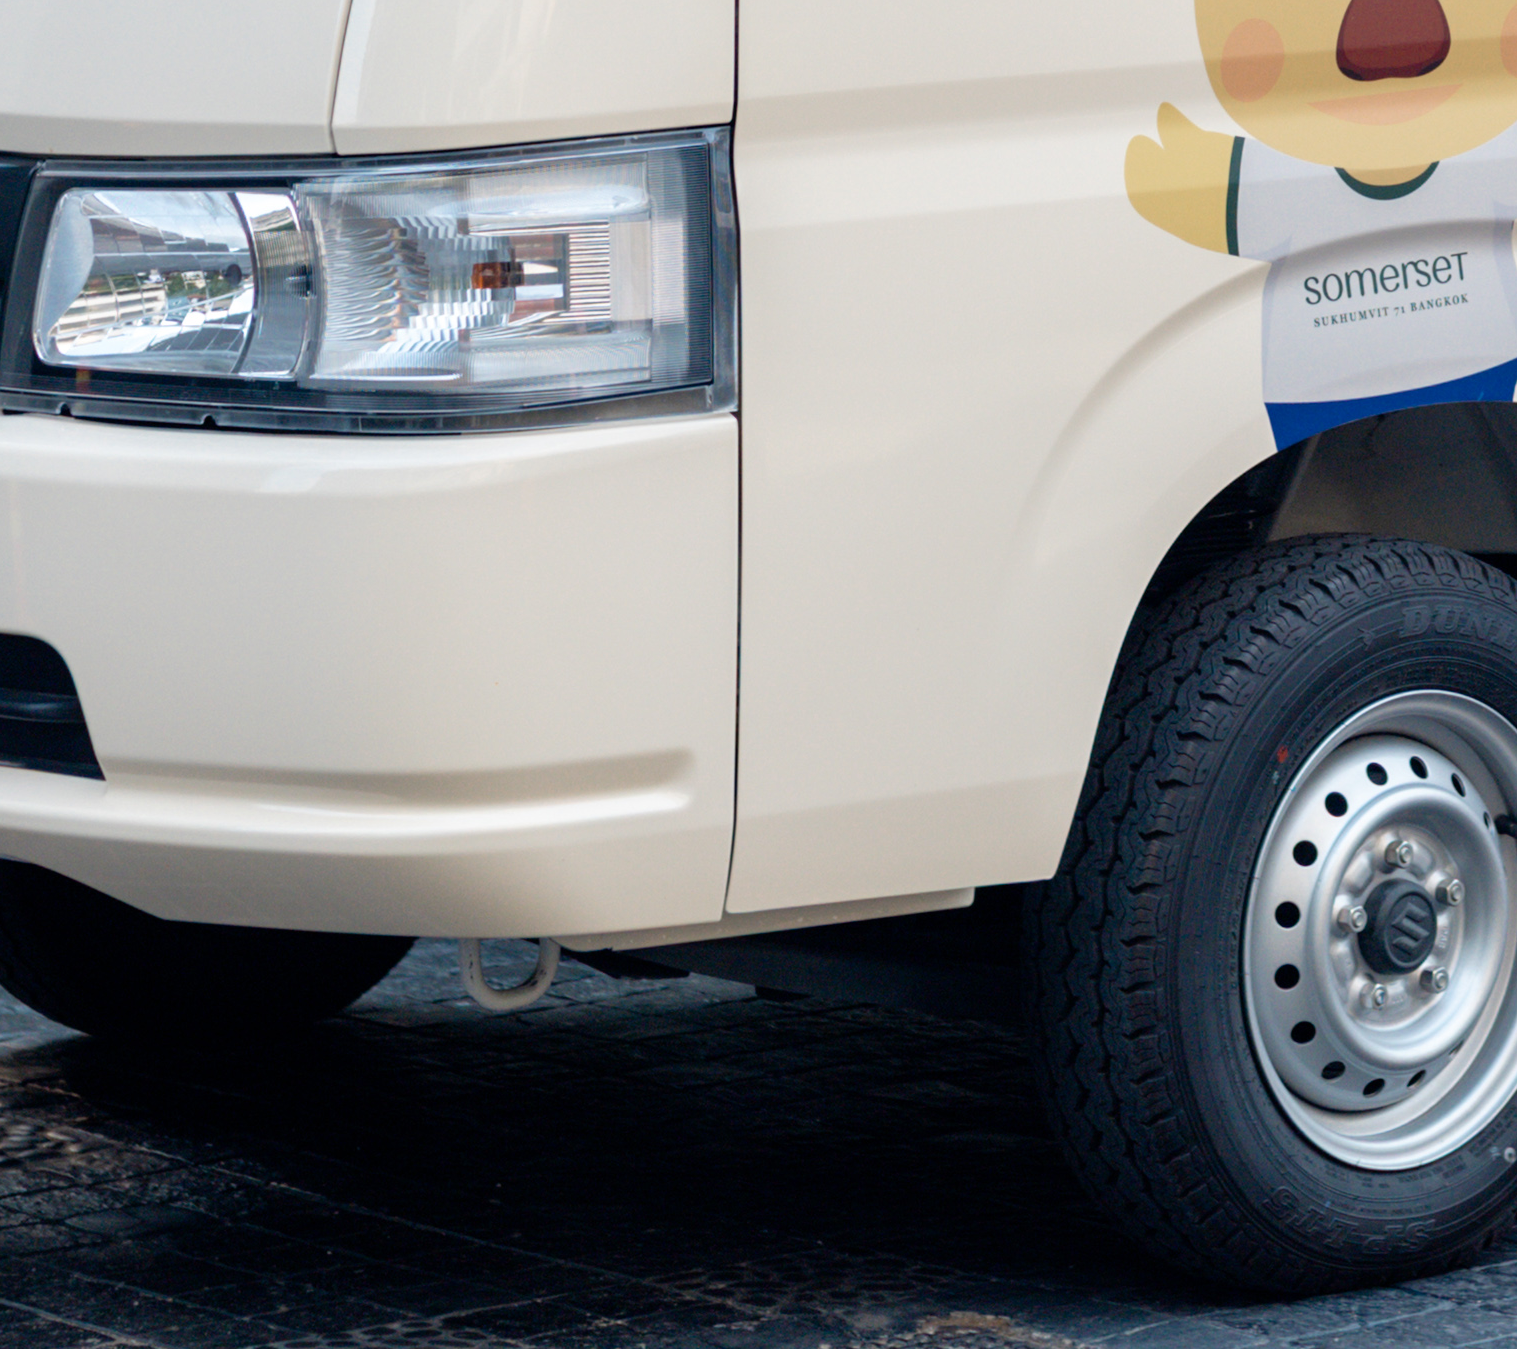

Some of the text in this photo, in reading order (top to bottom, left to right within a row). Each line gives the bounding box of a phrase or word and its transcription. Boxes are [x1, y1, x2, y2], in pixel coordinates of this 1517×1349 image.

[1313, 293, 1469, 328] SUKHUMVIT 71 BANGKOK
